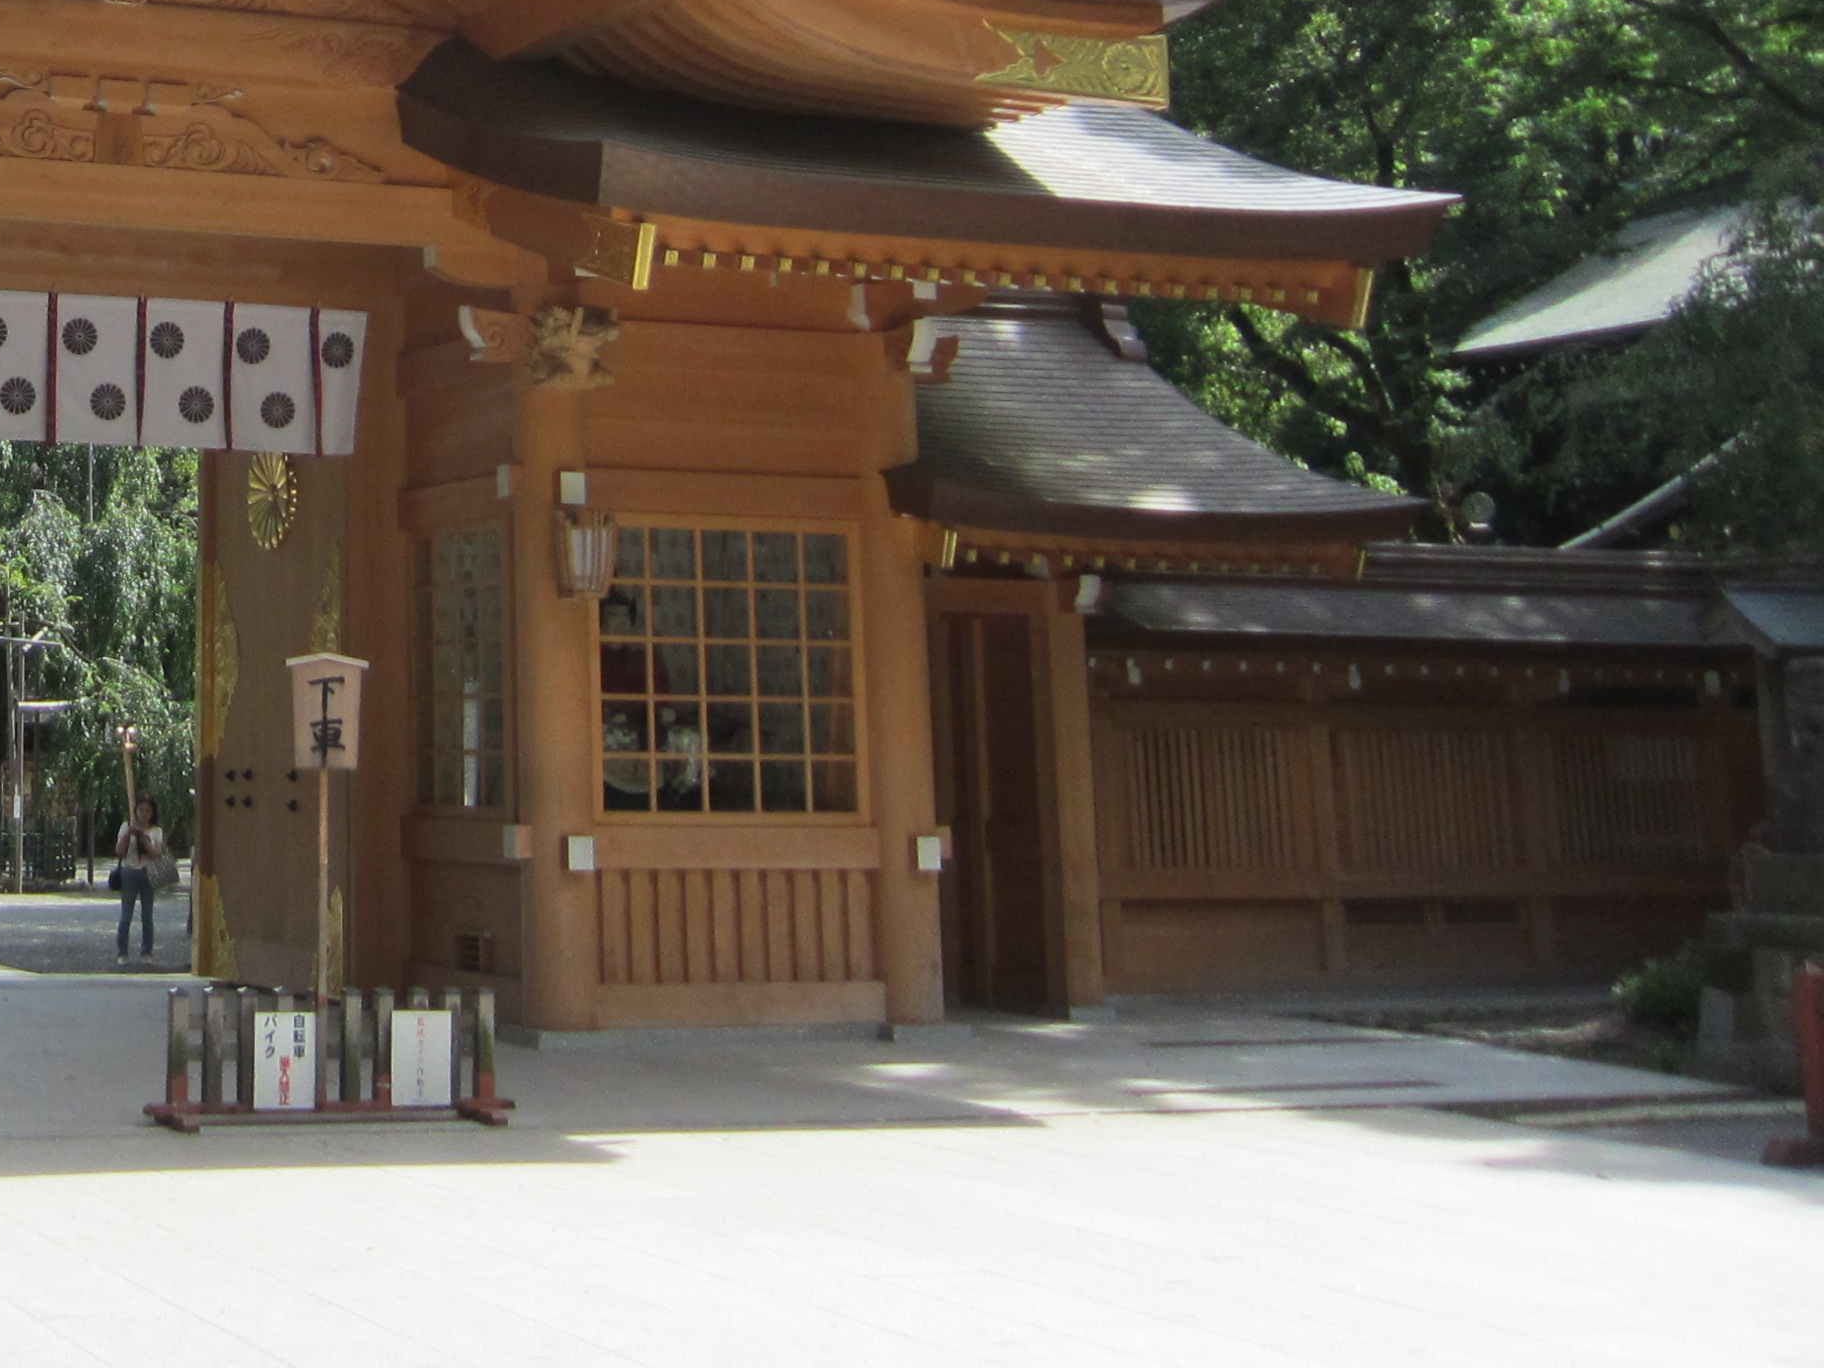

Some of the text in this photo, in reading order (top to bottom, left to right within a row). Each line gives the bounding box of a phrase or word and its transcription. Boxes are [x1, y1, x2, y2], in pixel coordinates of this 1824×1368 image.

[307, 675, 346, 767] 下車
[264, 1014, 277, 1059] バイク
[293, 1014, 305, 1059] 自転車
